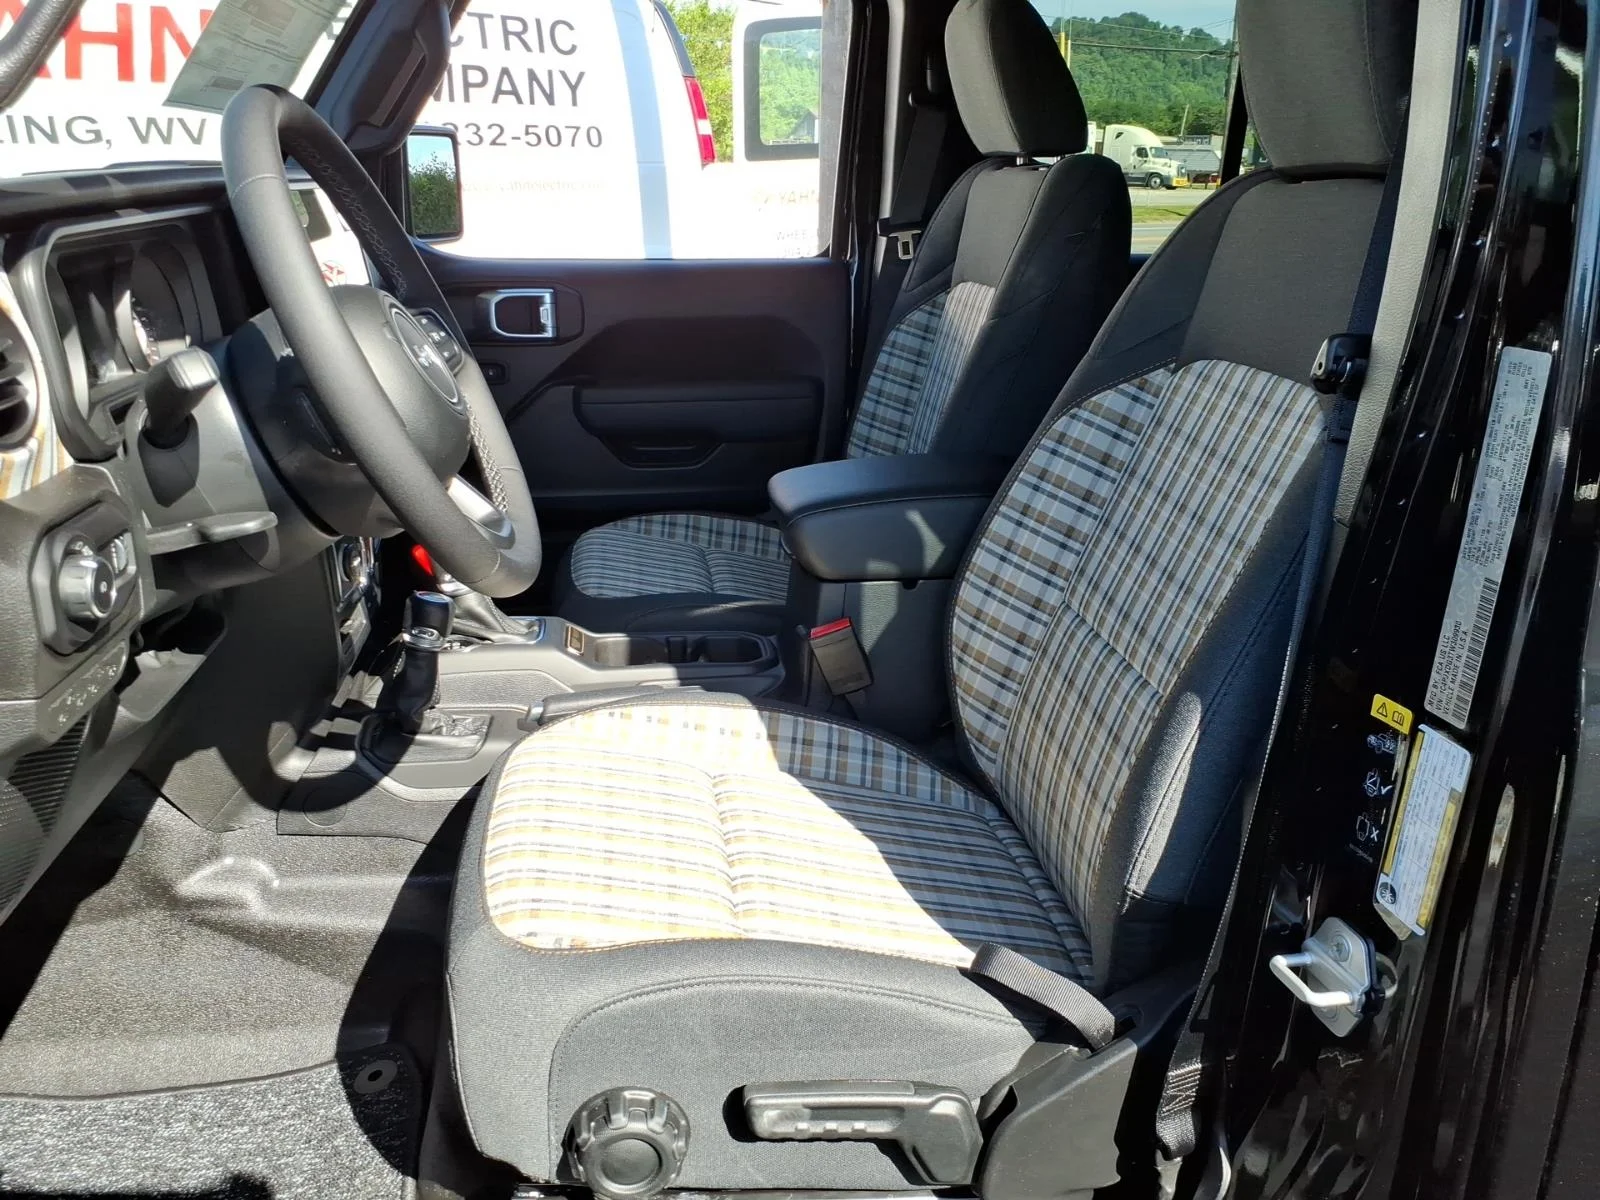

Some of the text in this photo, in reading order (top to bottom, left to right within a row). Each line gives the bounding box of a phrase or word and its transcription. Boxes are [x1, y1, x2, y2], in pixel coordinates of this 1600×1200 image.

[0, 114, 207, 150] ING, WV
[1443, 685, 1454, 714] VEHICLE
[1450, 663, 1460, 685] MADE
